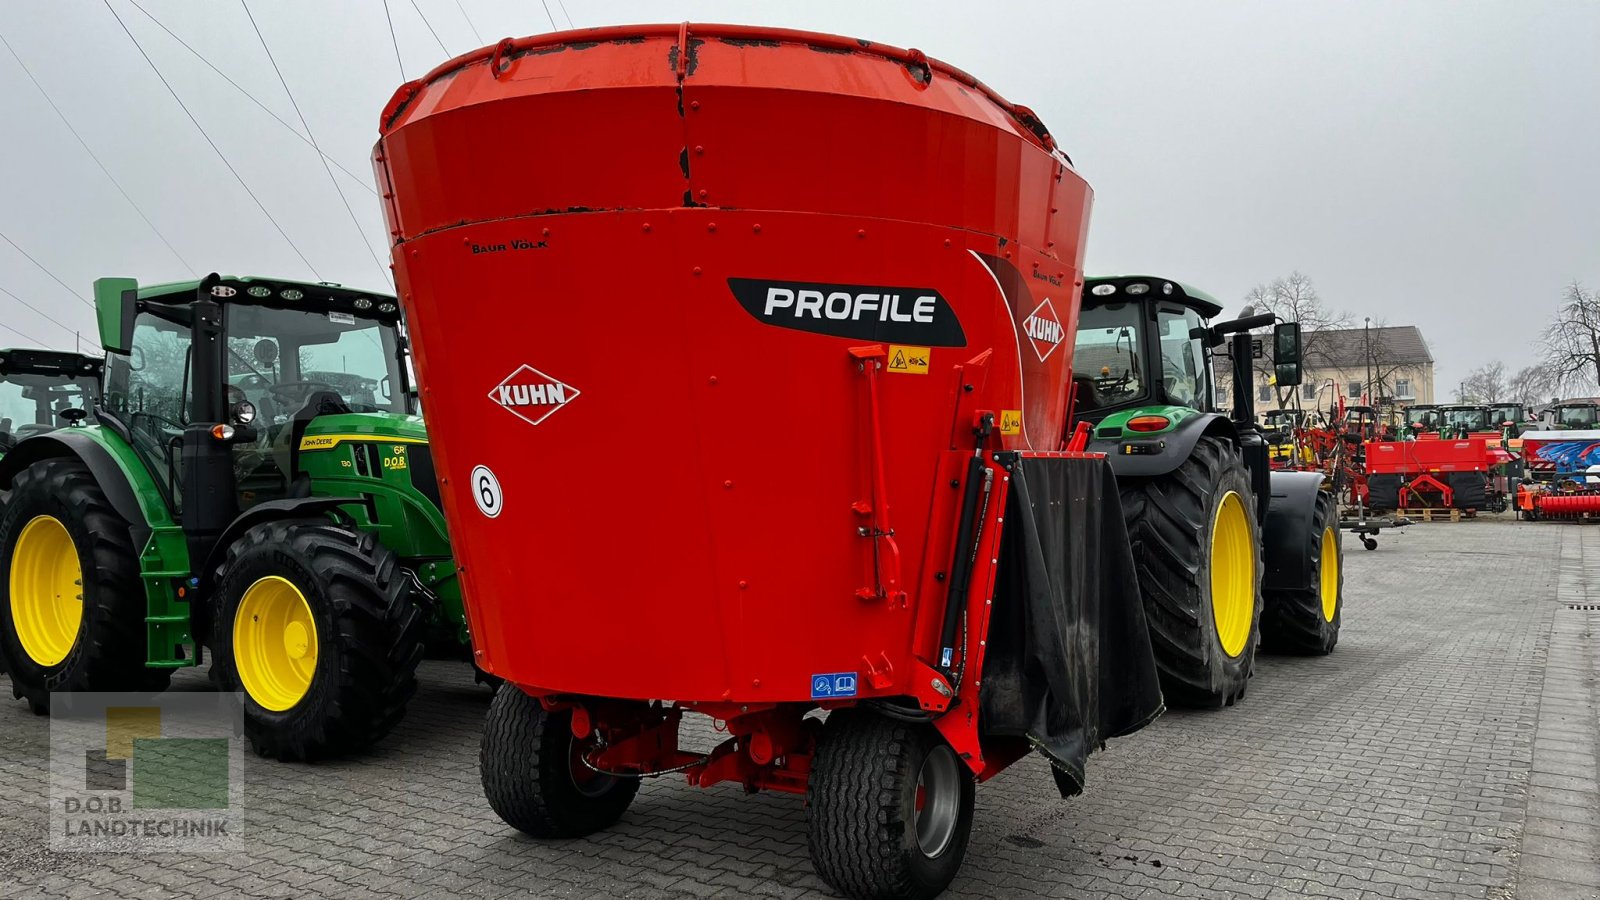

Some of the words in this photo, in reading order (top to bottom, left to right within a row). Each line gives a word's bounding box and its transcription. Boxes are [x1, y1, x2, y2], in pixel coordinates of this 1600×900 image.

[764, 287, 937, 323] PROFILE
[1029, 315, 1060, 344] KUHN
[499, 383, 566, 406] KUHN
[393, 445, 405, 455] 6R
[479, 475, 495, 509] 6
